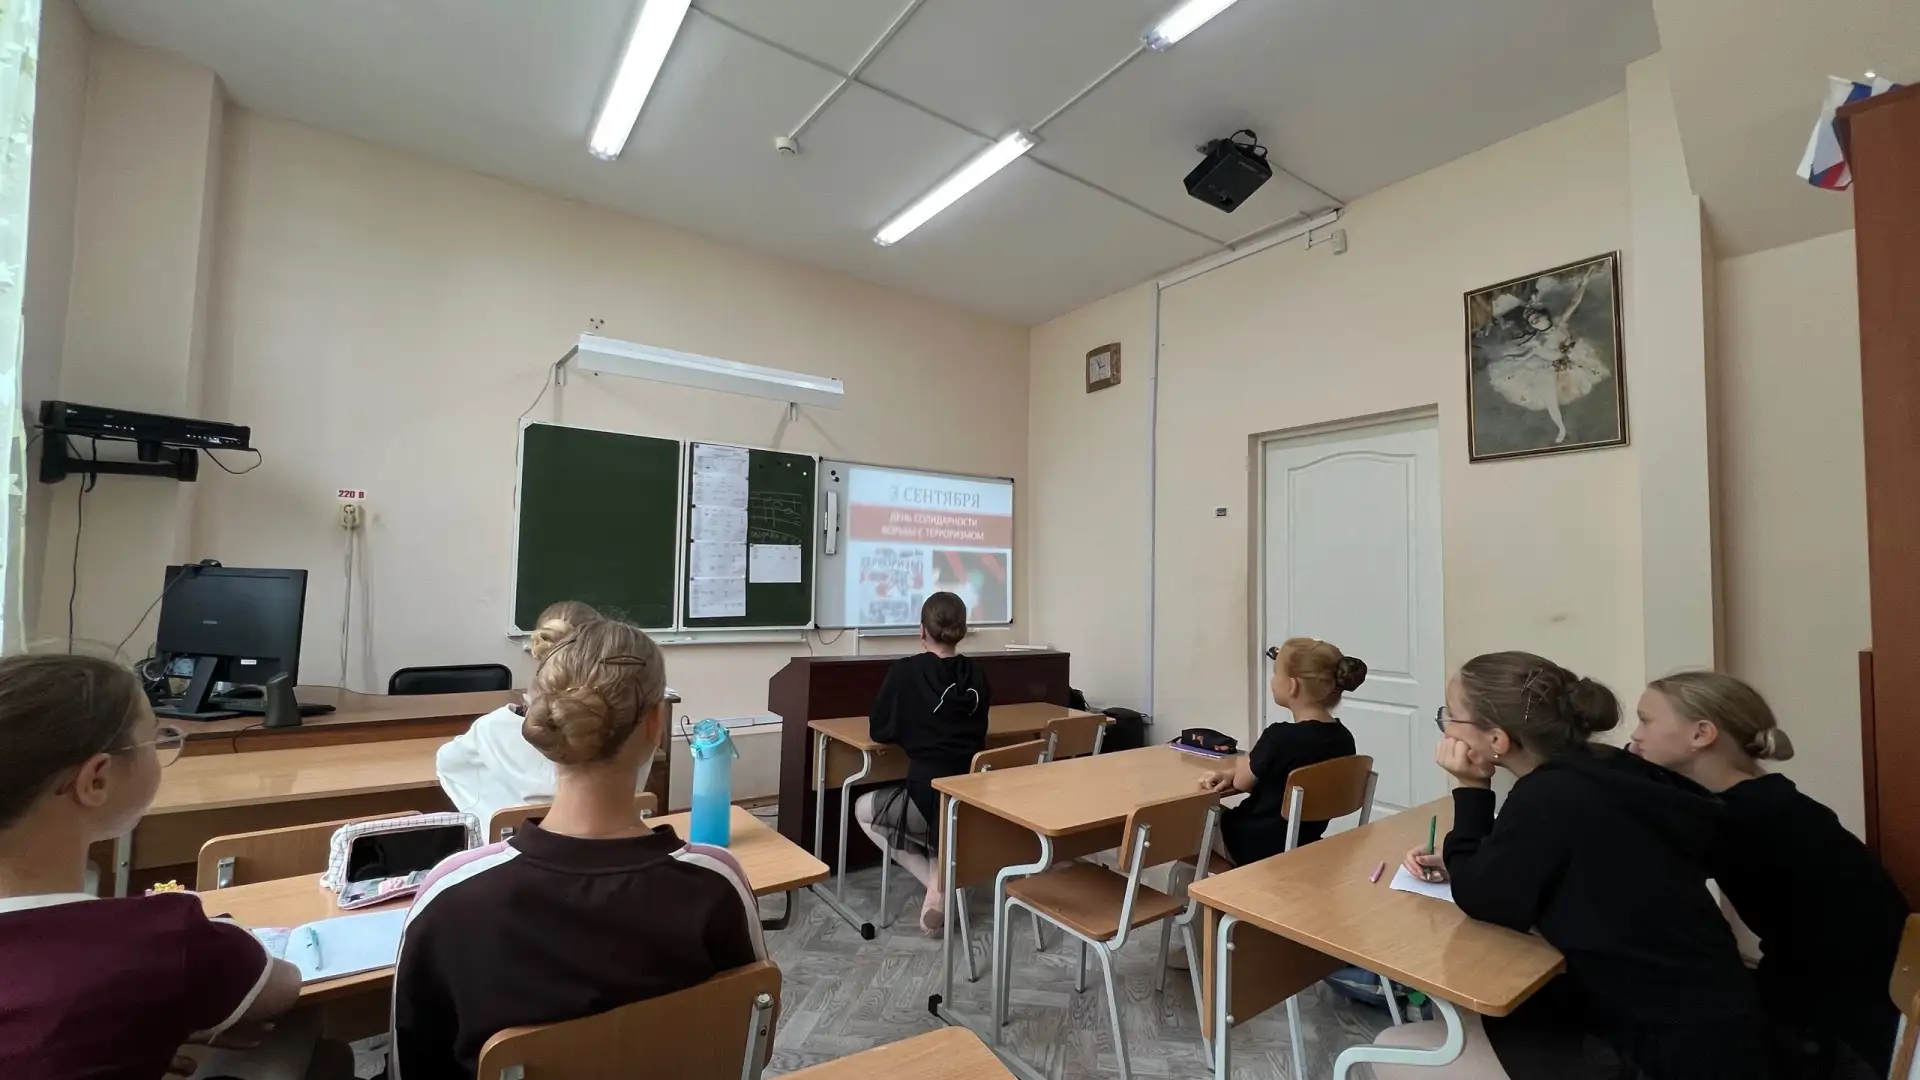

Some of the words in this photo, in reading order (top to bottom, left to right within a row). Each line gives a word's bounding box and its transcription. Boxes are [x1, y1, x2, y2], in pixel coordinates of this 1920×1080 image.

[338, 489, 356, 499] 220
[891, 486, 899, 501] 3
[903, 487, 980, 509] СЕНТЯБРЯ
[914, 513, 978, 527] СОЛИДАРНОСТИ
[926, 528, 985, 540] ТЕРРОРИЗМОМ
